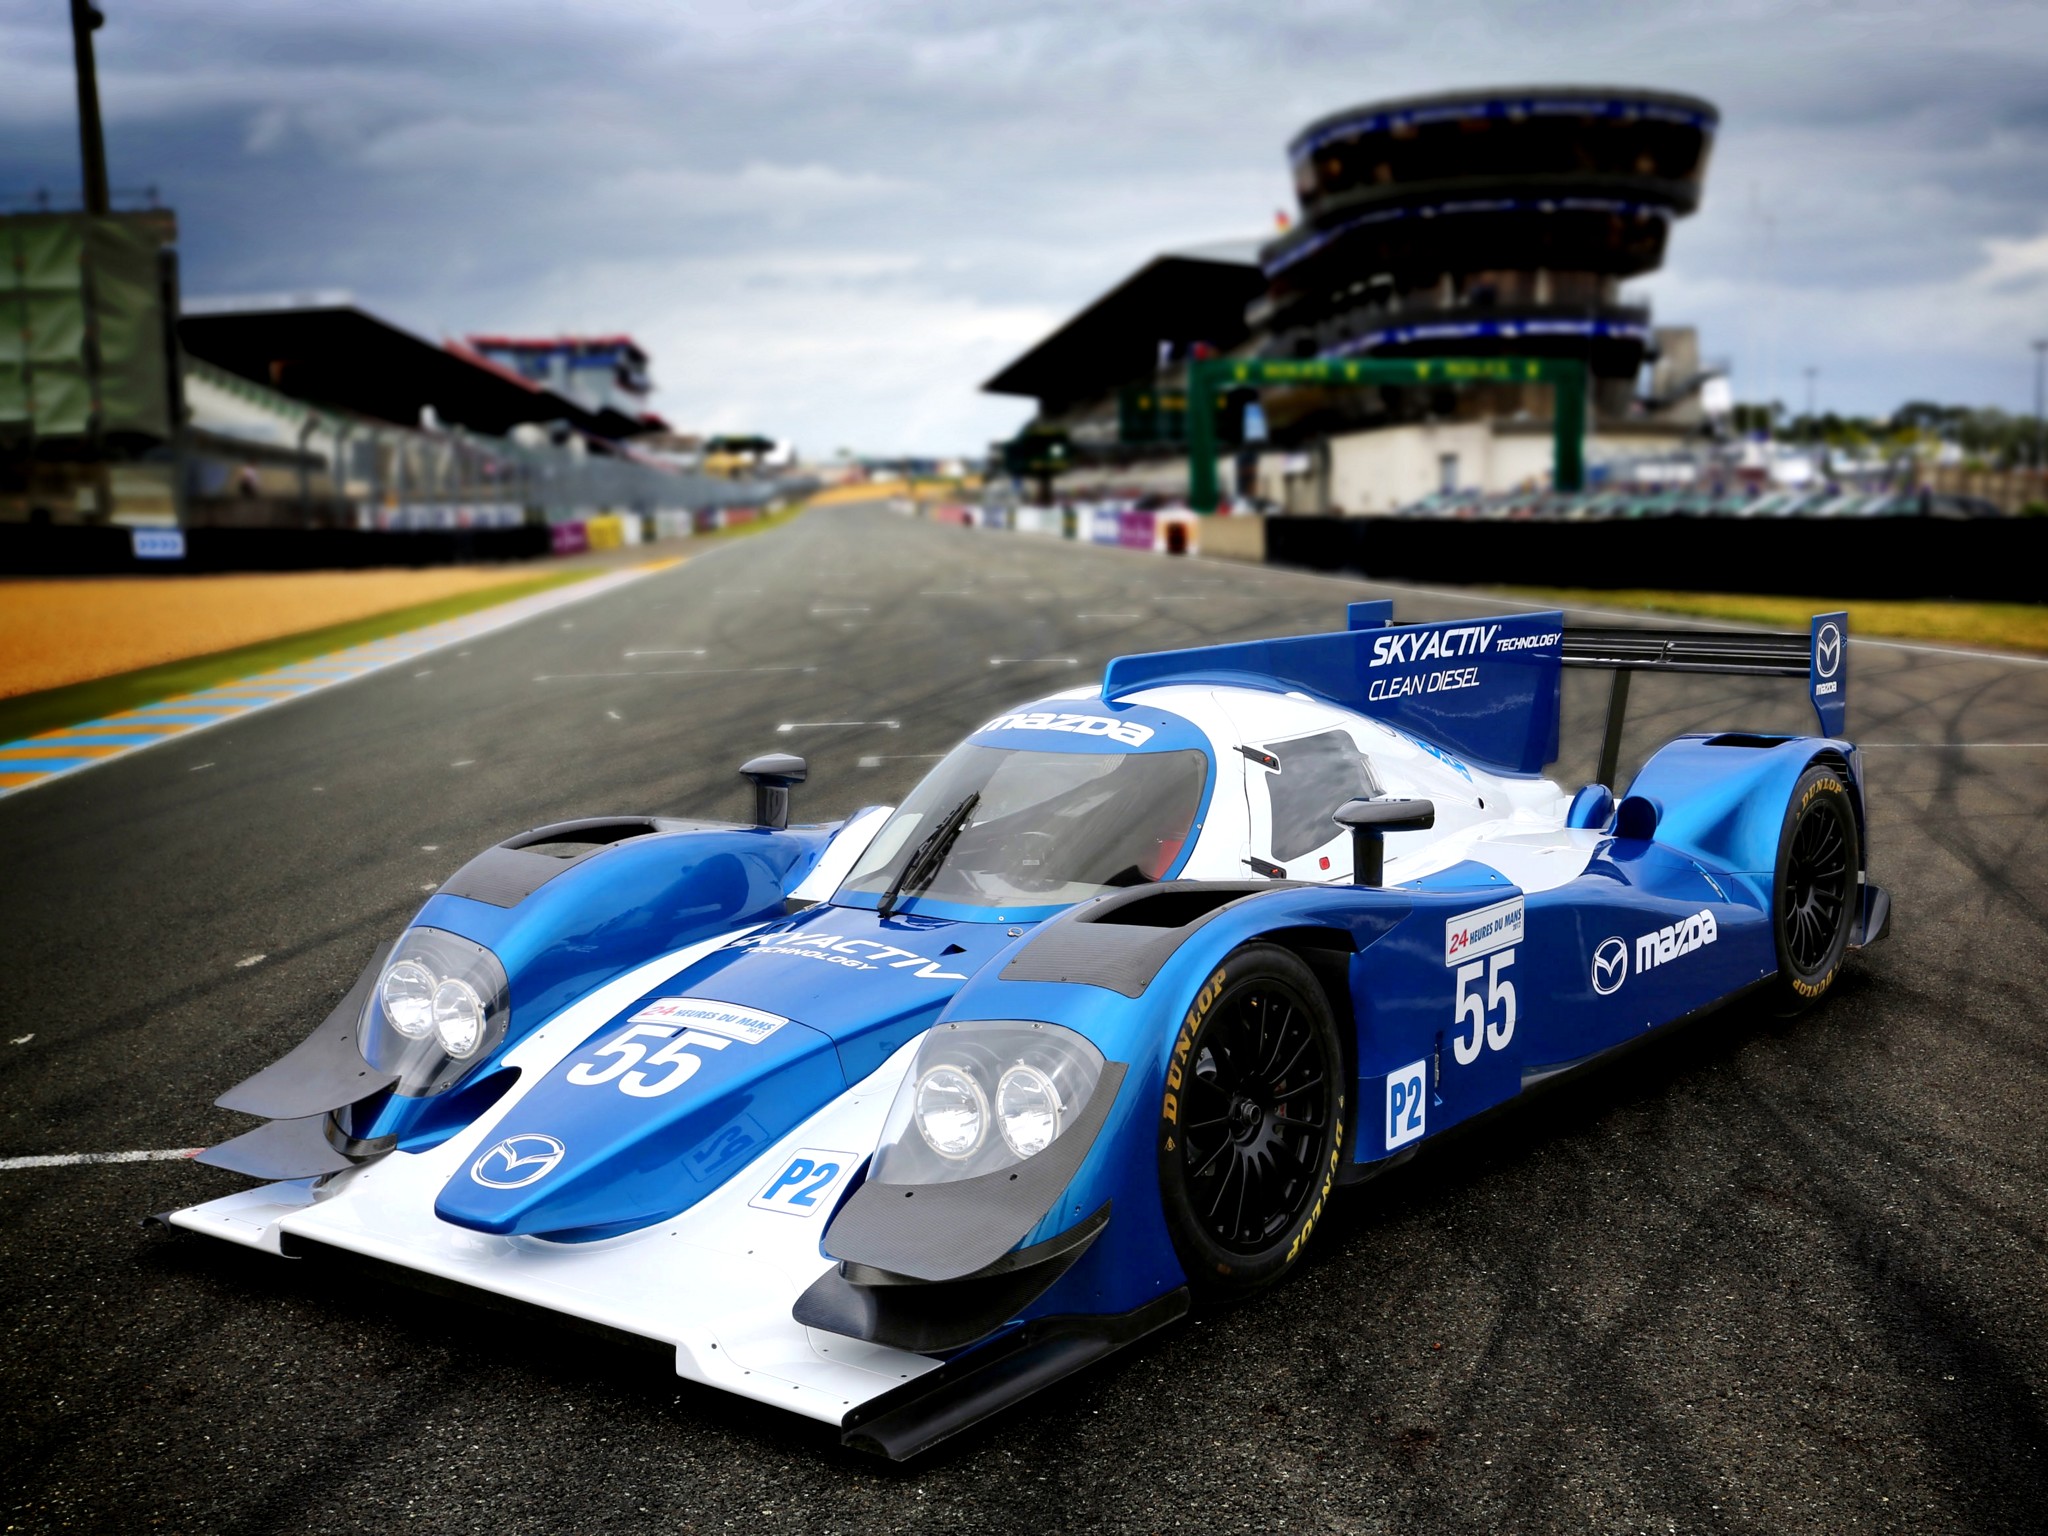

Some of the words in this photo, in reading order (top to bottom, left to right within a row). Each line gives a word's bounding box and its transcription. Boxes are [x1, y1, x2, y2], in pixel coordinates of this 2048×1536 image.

[1369, 625, 1498, 667] SKYACTIV
[1496, 633, 1561, 652] TECHNOLOGY
[1369, 674, 1426, 701] CLEAN
[1427, 667, 1480, 693] DIESEL
[972, 712, 1155, 748] mazda
[1801, 777, 1842, 810] DUNLOP
[1449, 928, 1469, 955] 24
[1470, 922, 1493, 945] HEURES
[1494, 917, 1504, 933] DU
[1504, 907, 1522, 928] MANS
[1636, 908, 1718, 975] mazda
[740, 946, 879, 971] TECHNOLOGY
[1453, 948, 1517, 1066] 55
[1793, 968, 1833, 998] DUNLOP
[641, 1005, 680, 1017] 24
[672, 1009, 720, 1020] HEURES
[716, 1013, 740, 1023] DU
[735, 1017, 776, 1031] MANS
[566, 1024, 733, 1098] 55
[1163, 967, 1227, 1126] DUNLOP
[1391, 1075, 1422, 1139] P2
[762, 1158, 840, 1207] P2
[1286, 1118, 1343, 1263] DUNLOP
